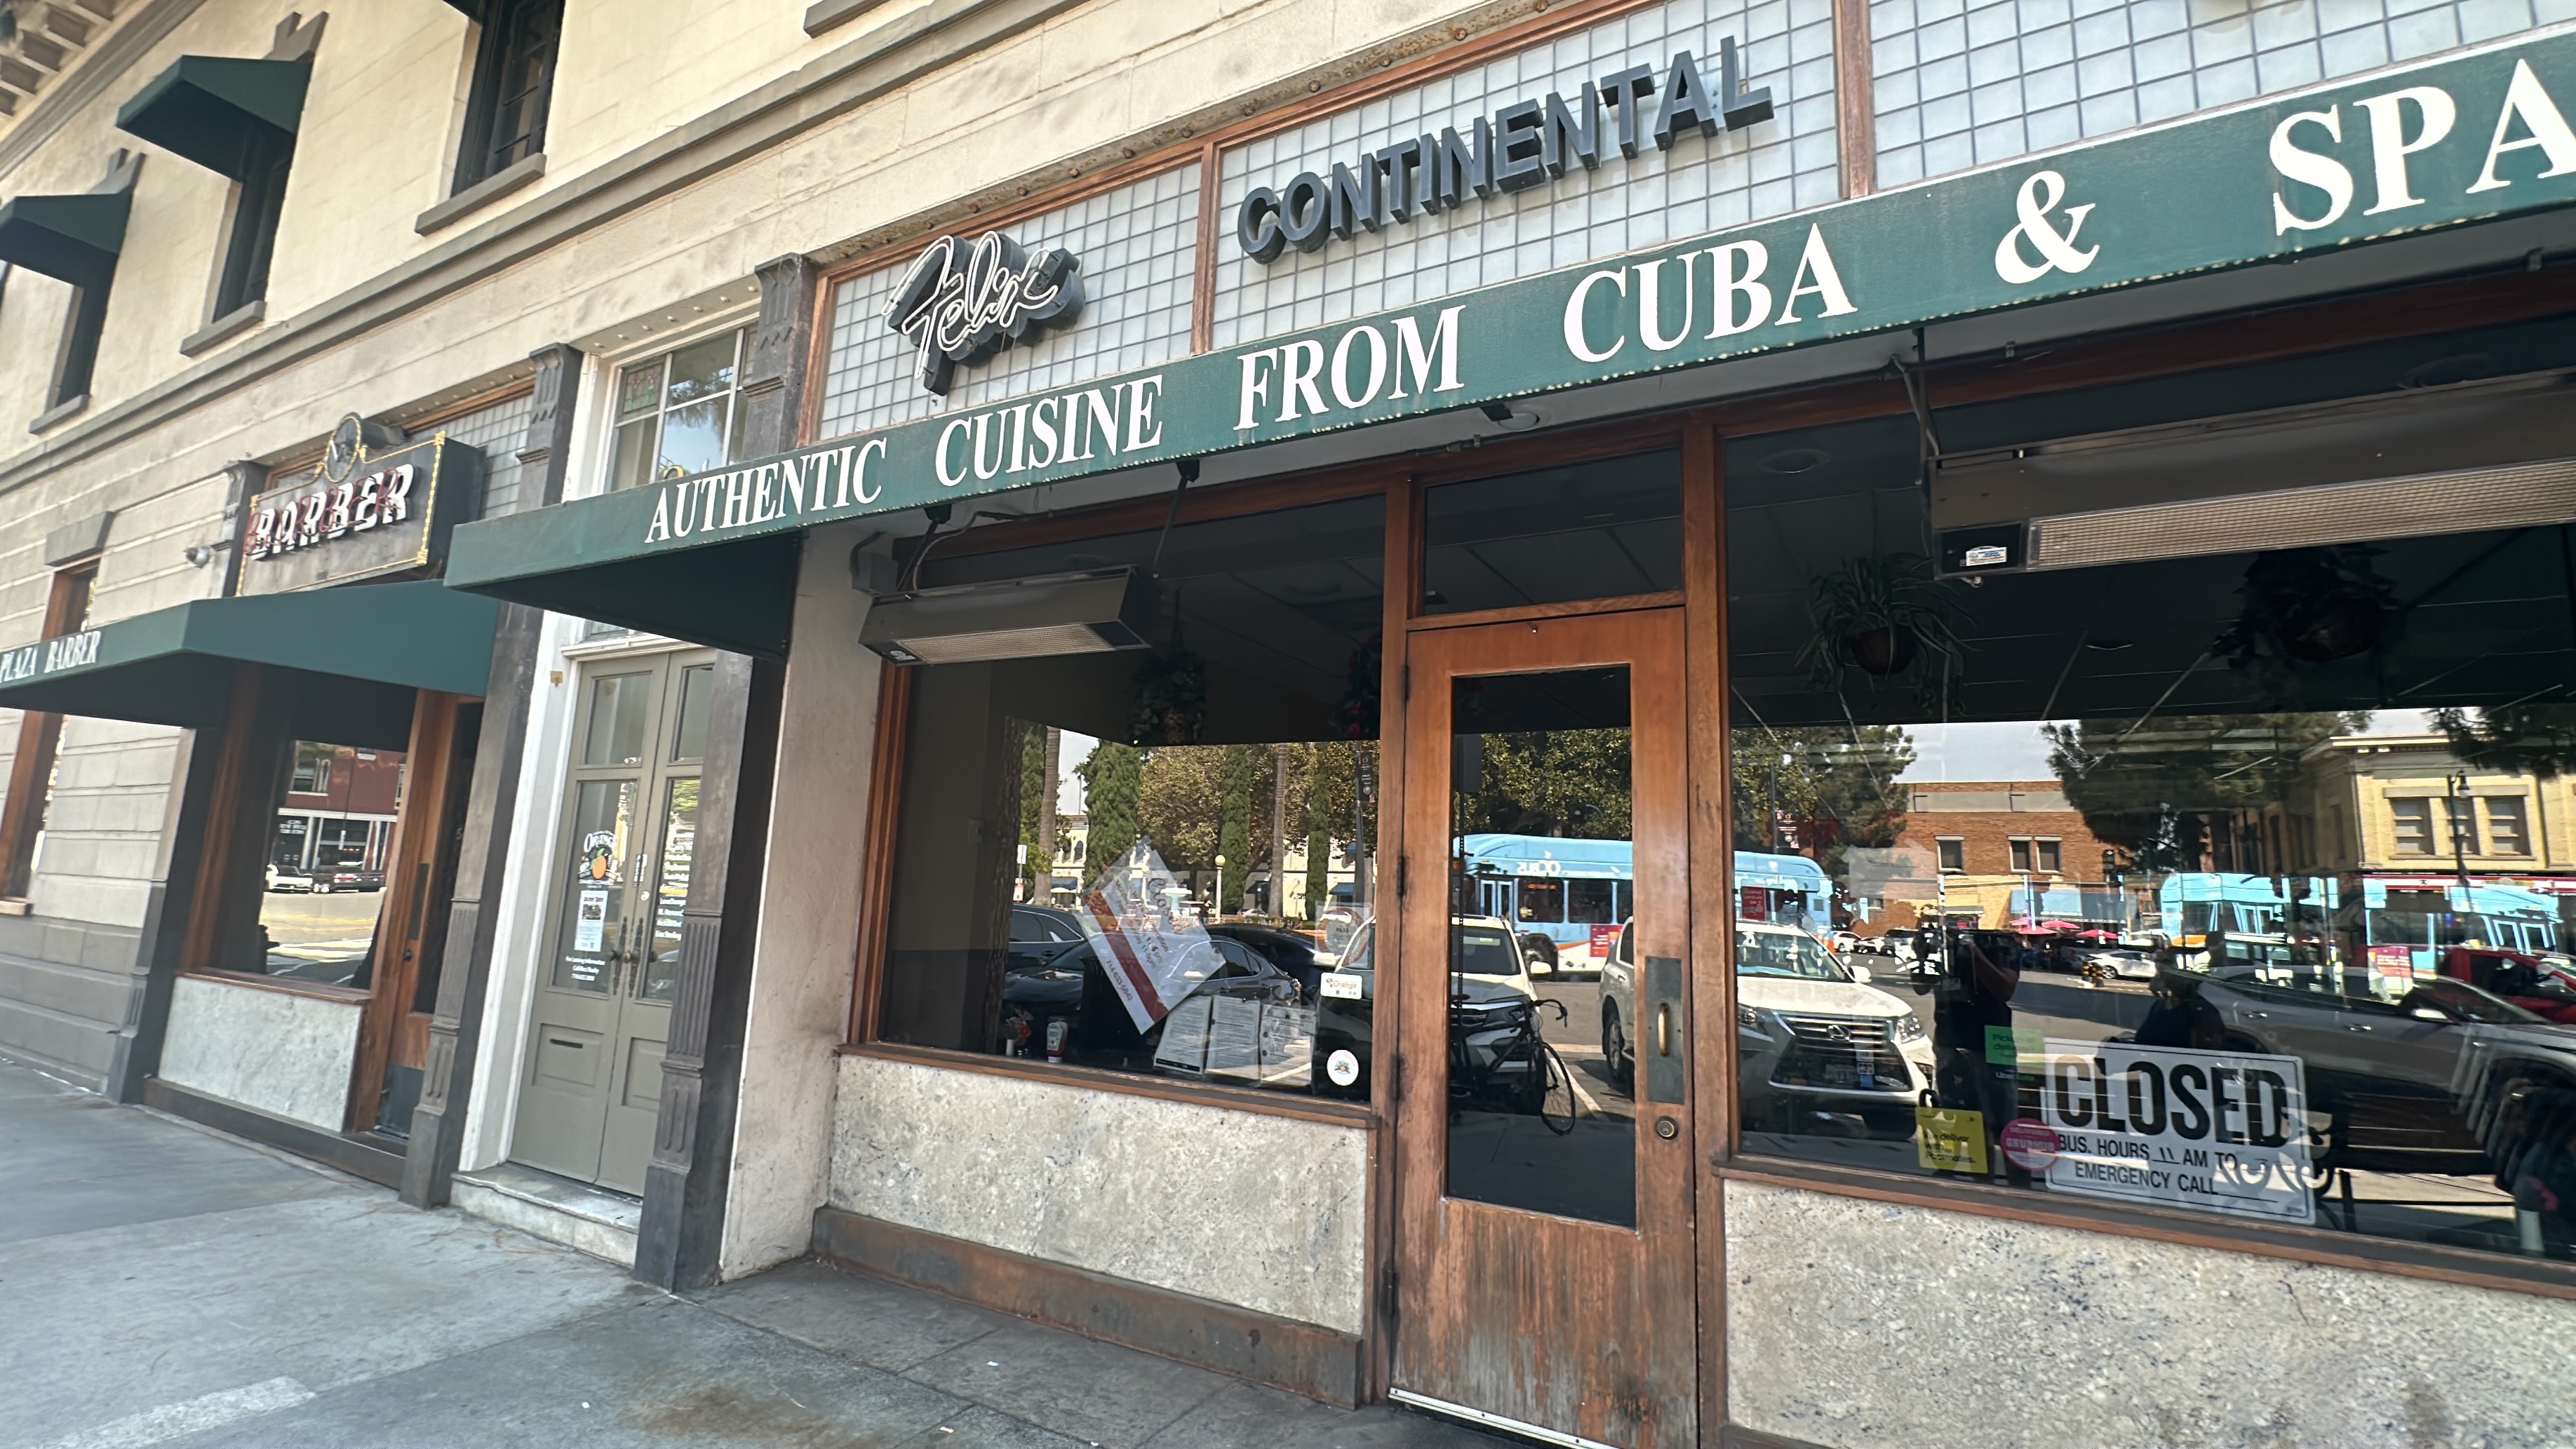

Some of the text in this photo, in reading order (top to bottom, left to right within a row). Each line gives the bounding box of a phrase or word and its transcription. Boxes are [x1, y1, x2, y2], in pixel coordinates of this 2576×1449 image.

[1237, 36, 1773, 265] CONTINENTAL
[881, 231, 1072, 388] Felix
[645, 437, 887, 544] AUTHENTIC
[935, 375, 1163, 487] CUISINE
[1234, 304, 1466, 431] FROM
[1564, 222, 1858, 363] CUBA
[1994, 170, 2100, 284] &
[243, 464, 414, 560] BARBER
[0, 631, 101, 683] PLAZA BARBER
[1333, 980, 1357, 990] Orange
[2055, 1055, 2290, 1148] CLOSED
[2006, 1138, 2055, 1152] GRUBHUB
[2058, 1133, 2092, 1154] BUS.
[2098, 1139, 2149, 1161] HOURS
[2182, 1148, 2208, 1168] AM
[2214, 1152, 2238, 1170] TO
[2075, 1161, 2219, 1196] EMERGENCY CALL
